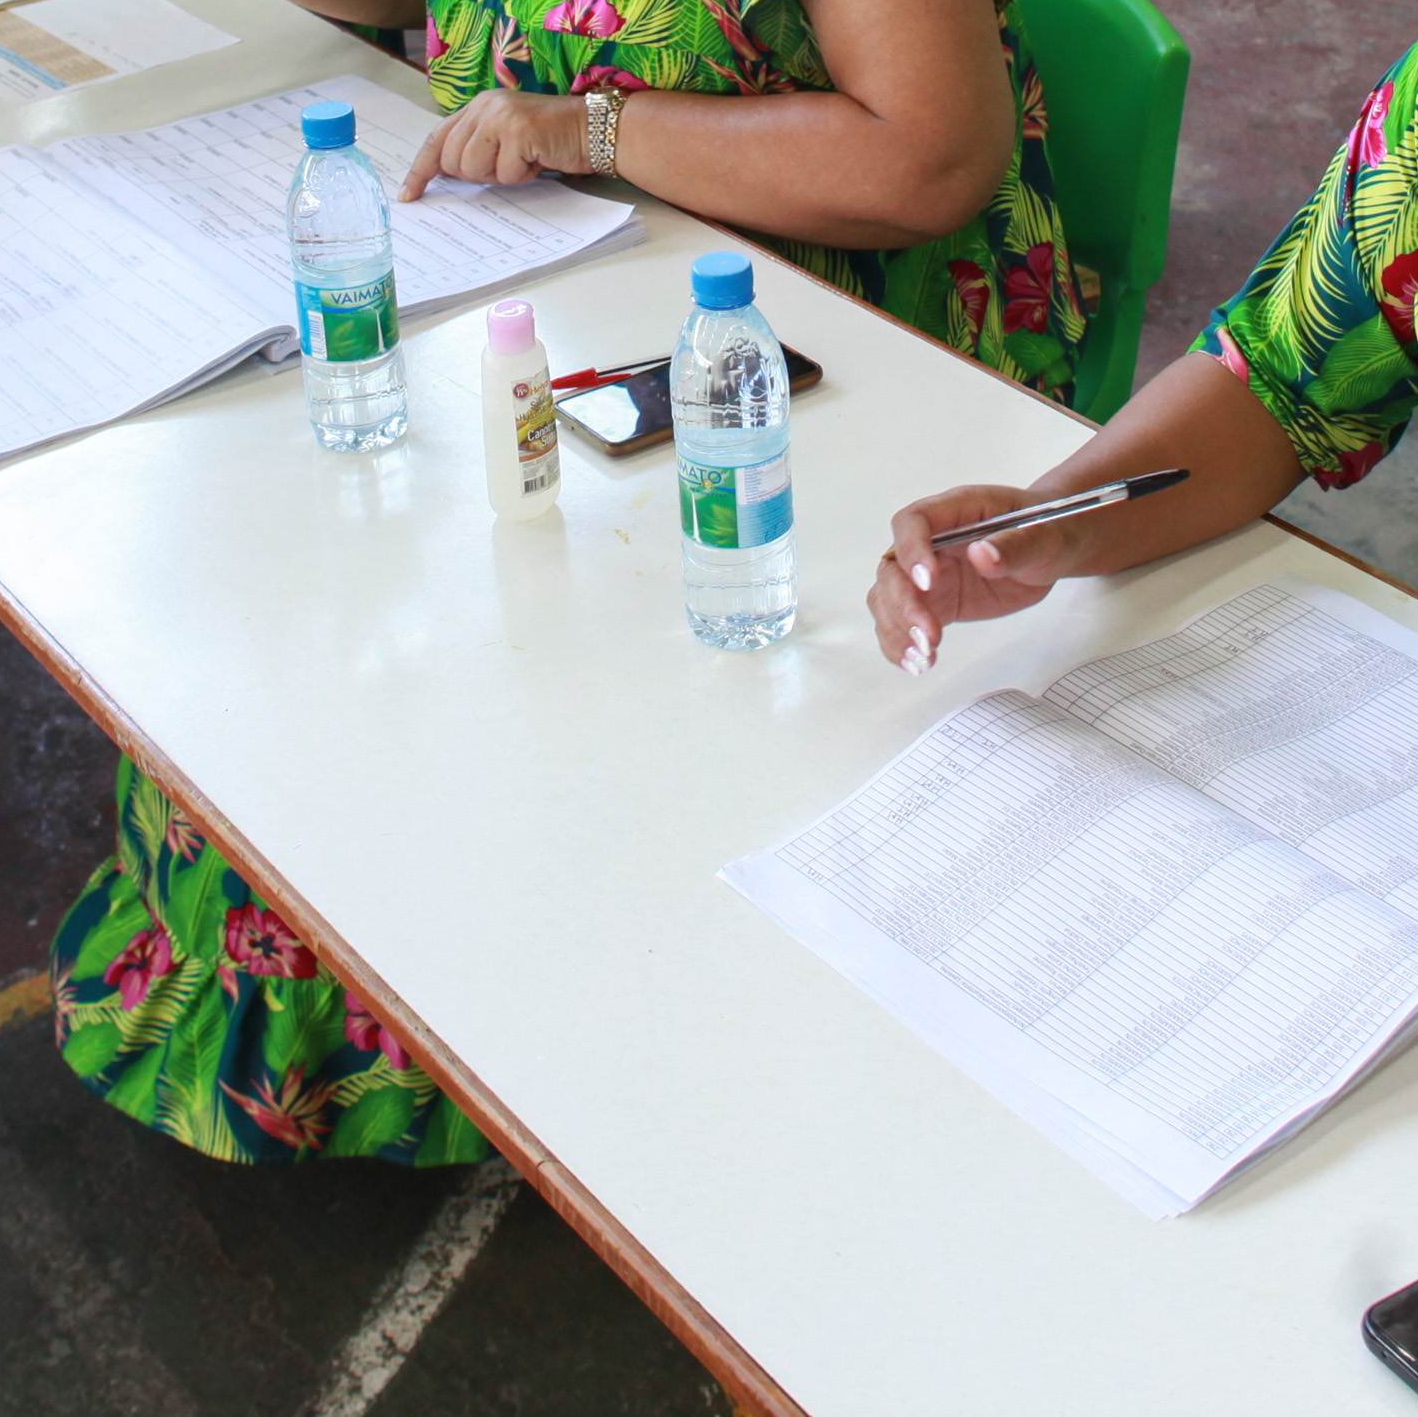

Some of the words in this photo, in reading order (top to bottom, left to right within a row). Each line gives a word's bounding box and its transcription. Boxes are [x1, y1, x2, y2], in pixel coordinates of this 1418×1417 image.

[331, 275, 394, 304] VAIMATO
[1170, 975, 1210, 1002] WINCHESTER
[1385, 984, 1400, 994] 312
[1377, 991, 1392, 1002] 311
[1346, 1024, 1360, 1034] 307
[1322, 1049, 1338, 1060] 304
[1306, 1065, 1322, 1076] 302
[1299, 1073, 1313, 1084] 301
